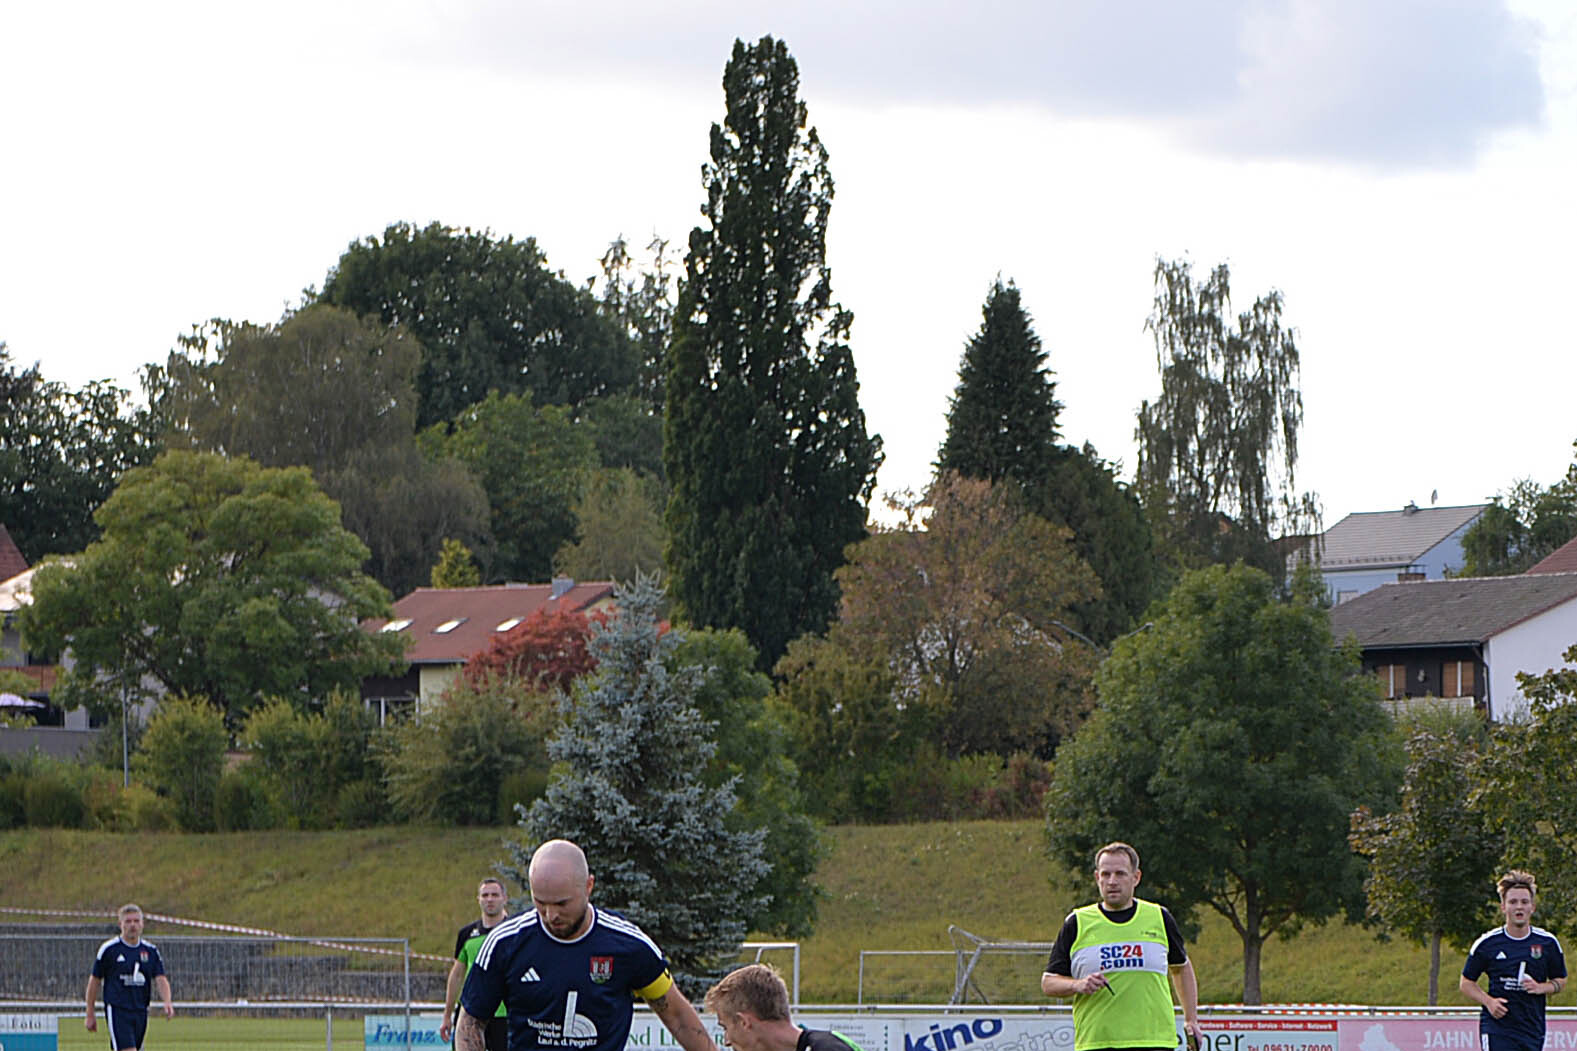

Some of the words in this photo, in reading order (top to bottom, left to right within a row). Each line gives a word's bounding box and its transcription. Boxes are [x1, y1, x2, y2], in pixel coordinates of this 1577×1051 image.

[1100, 944, 1143, 960] SC24
[1100, 958, 1144, 971] .com
[373, 1023, 436, 1043] Franz
[1424, 1031, 1473, 1049] JAHN
